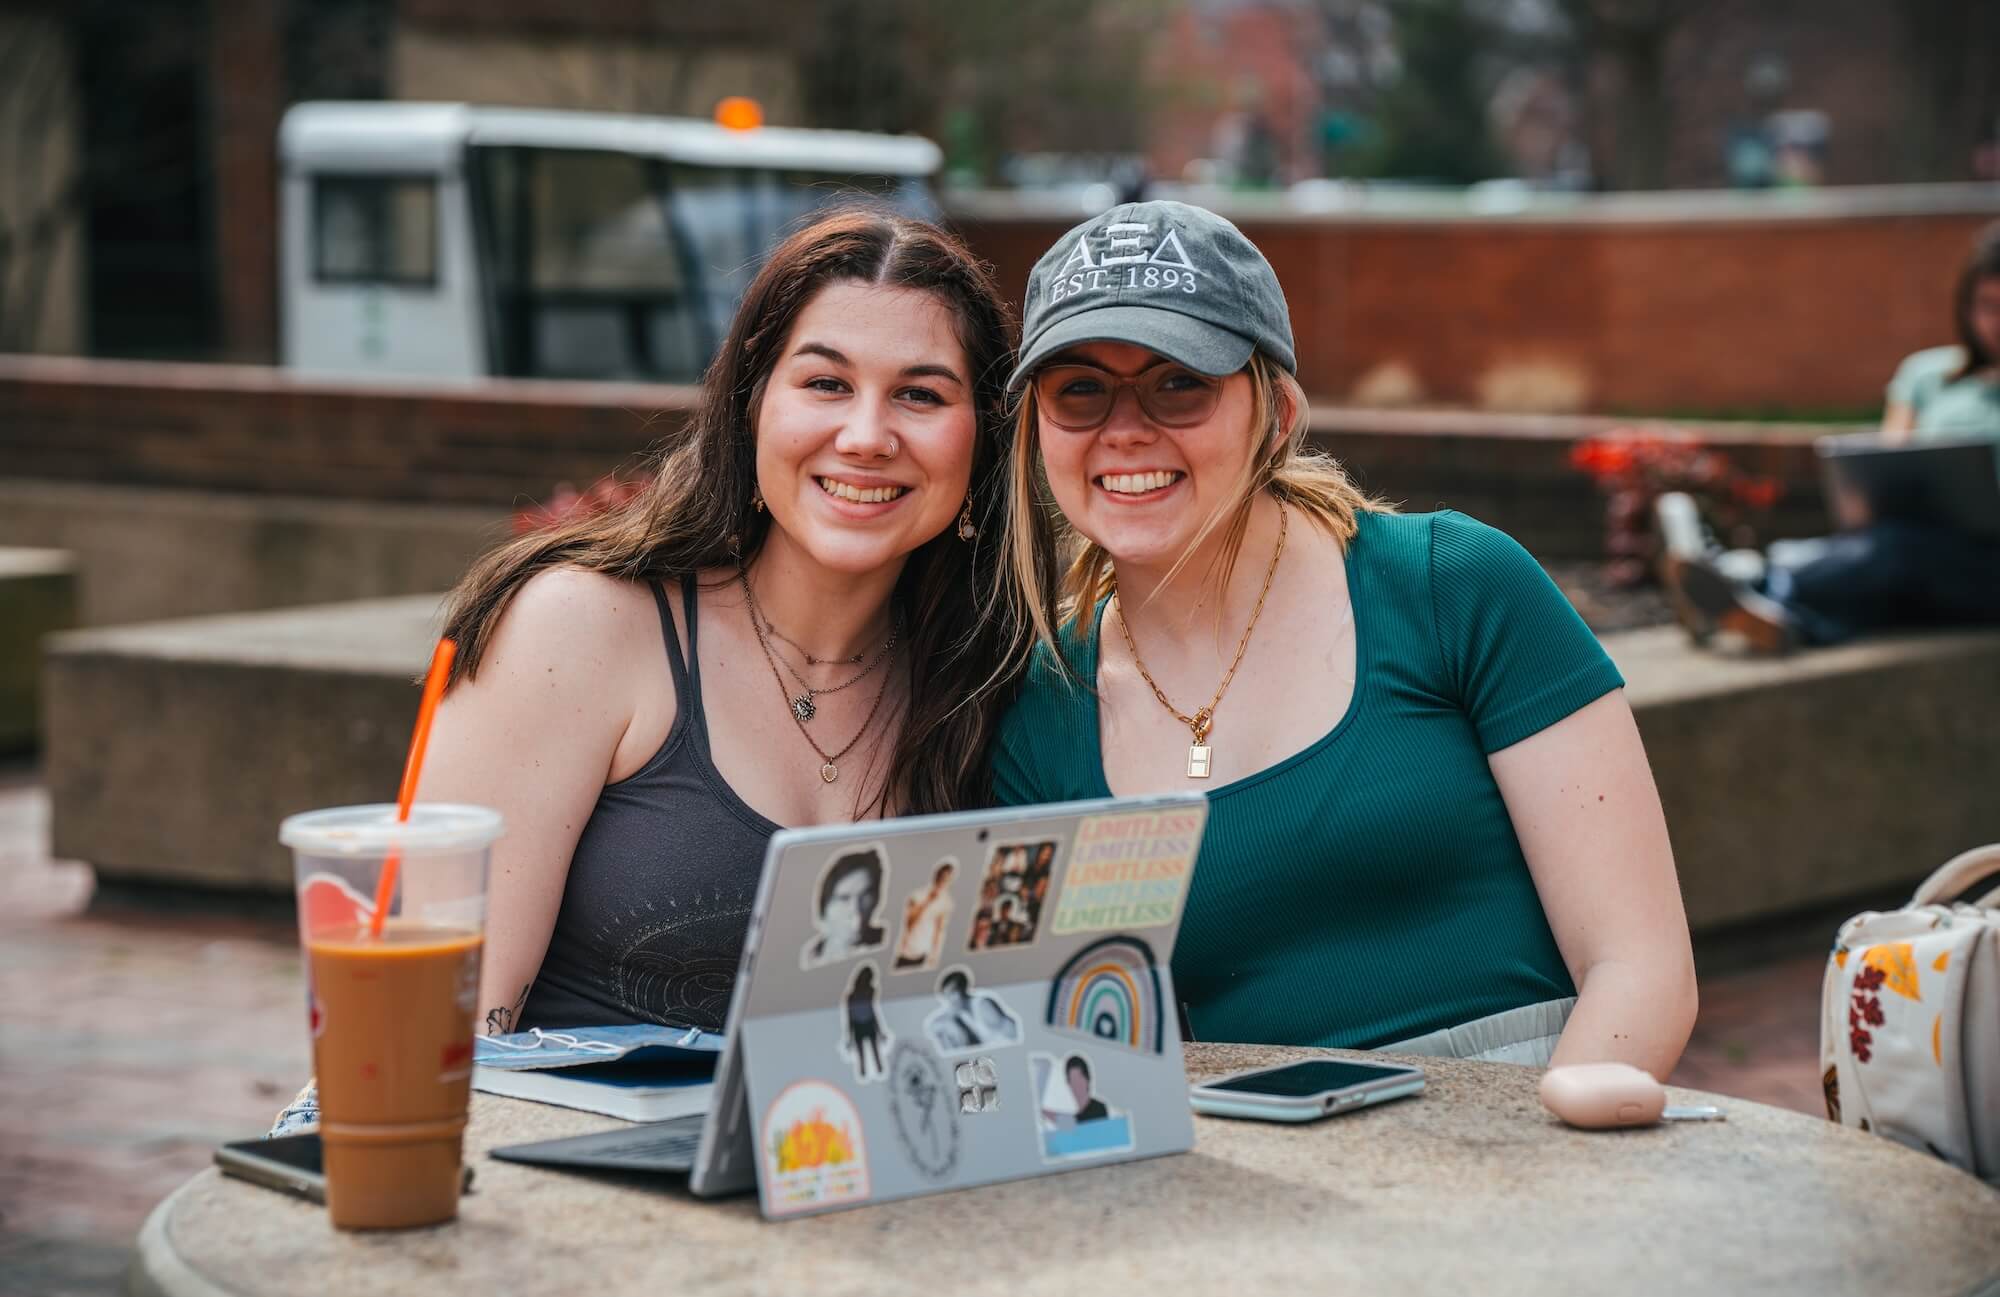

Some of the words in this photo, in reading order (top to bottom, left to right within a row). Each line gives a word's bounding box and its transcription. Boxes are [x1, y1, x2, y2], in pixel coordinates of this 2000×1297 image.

[1050, 269, 1112, 305] EST.
[1126, 266, 1197, 294] 1893
[1069, 858, 1185, 886] LIMITLESS
[1056, 901, 1173, 929] LIMITLESS
